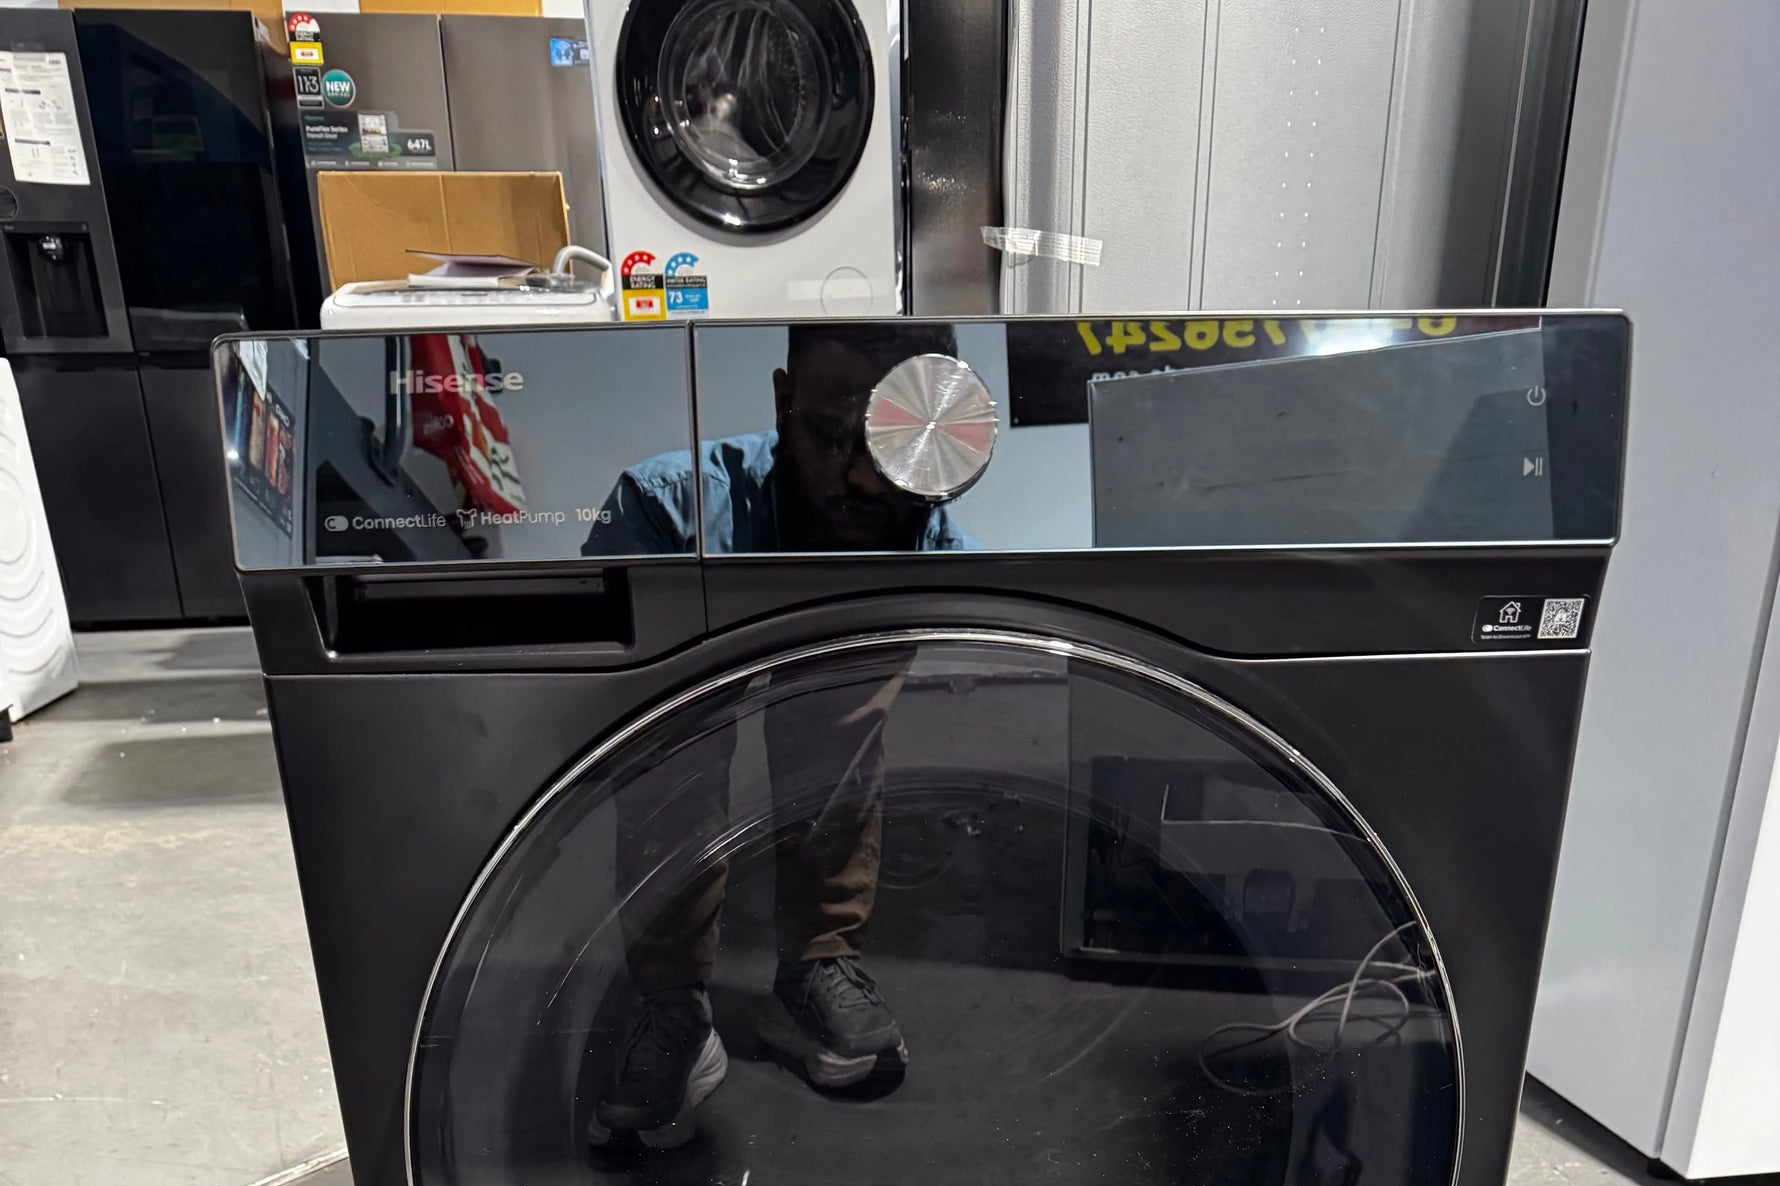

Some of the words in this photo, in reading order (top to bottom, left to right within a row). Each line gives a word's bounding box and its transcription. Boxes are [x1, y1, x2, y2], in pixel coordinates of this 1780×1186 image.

[325, 80, 350, 92] NEW
[406, 139, 432, 151] 647L
[668, 291, 683, 304] 73
[389, 369, 524, 395] Hisense
[352, 513, 447, 530] ConnectLife
[480, 509, 566, 527] HeatPump
[575, 508, 612, 524] 10kg
[1493, 624, 1533, 632] ConnectLife
